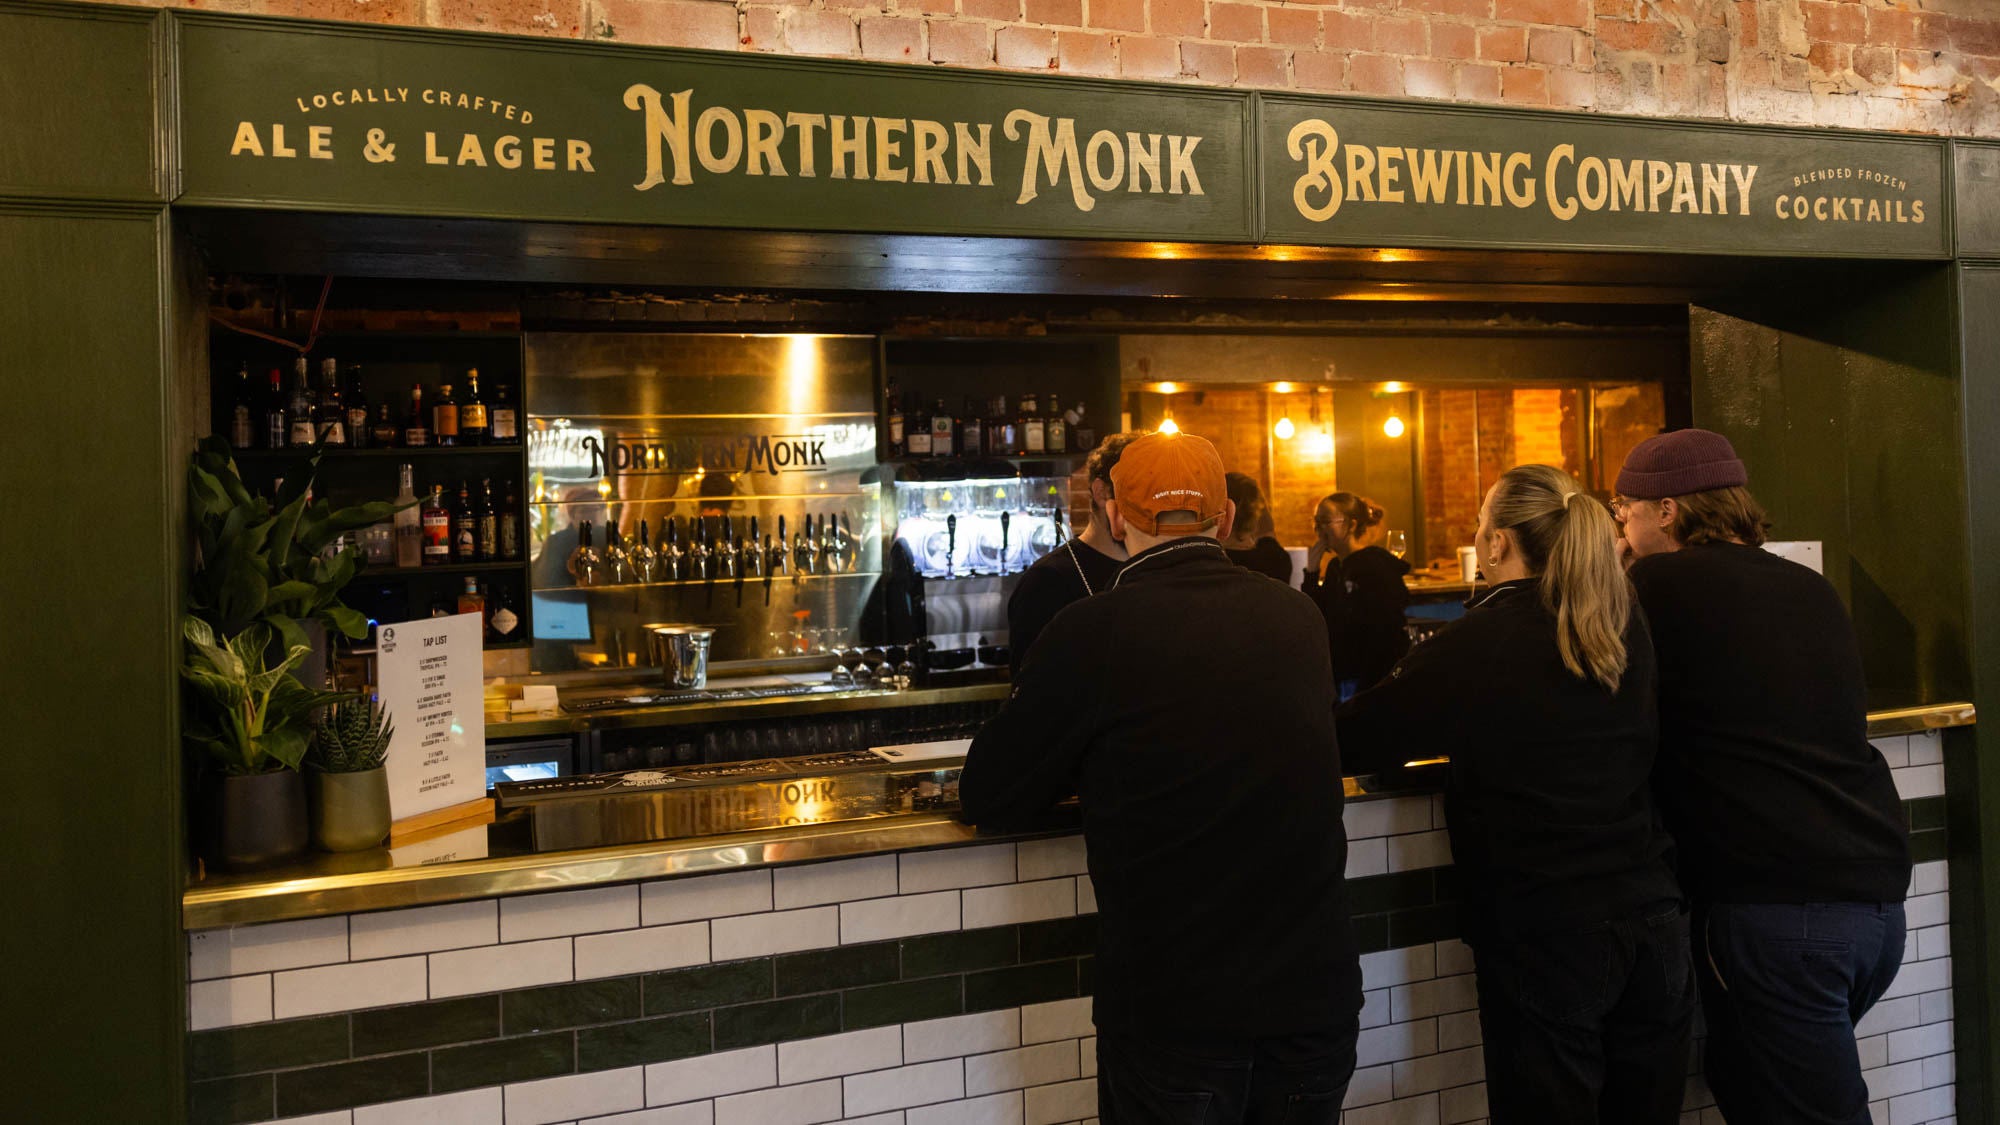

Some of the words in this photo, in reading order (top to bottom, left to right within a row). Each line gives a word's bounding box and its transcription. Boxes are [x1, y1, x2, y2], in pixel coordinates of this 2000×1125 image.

[296, 88, 409, 113] LOCALLY
[422, 88, 534, 125] CRAFTED
[230, 121, 334, 160] ALE
[363, 127, 396, 164] &
[425, 131, 596, 173] LAGER
[623, 83, 995, 191] NORTHERN
[1003, 108, 1205, 212] MONK
[1286, 118, 1537, 222] BREWING
[1544, 143, 1759, 221] COMPANY
[1793, 167, 1852, 188] BLENDED
[1857, 168, 1907, 192] FROZEN
[1775, 194, 1926, 224] COCKTAILS
[582, 435, 737, 479] NORTRN
[738, 433, 827, 476] MONK
[423, 636, 434, 648] TAP
[435, 635, 447, 645] LIST
